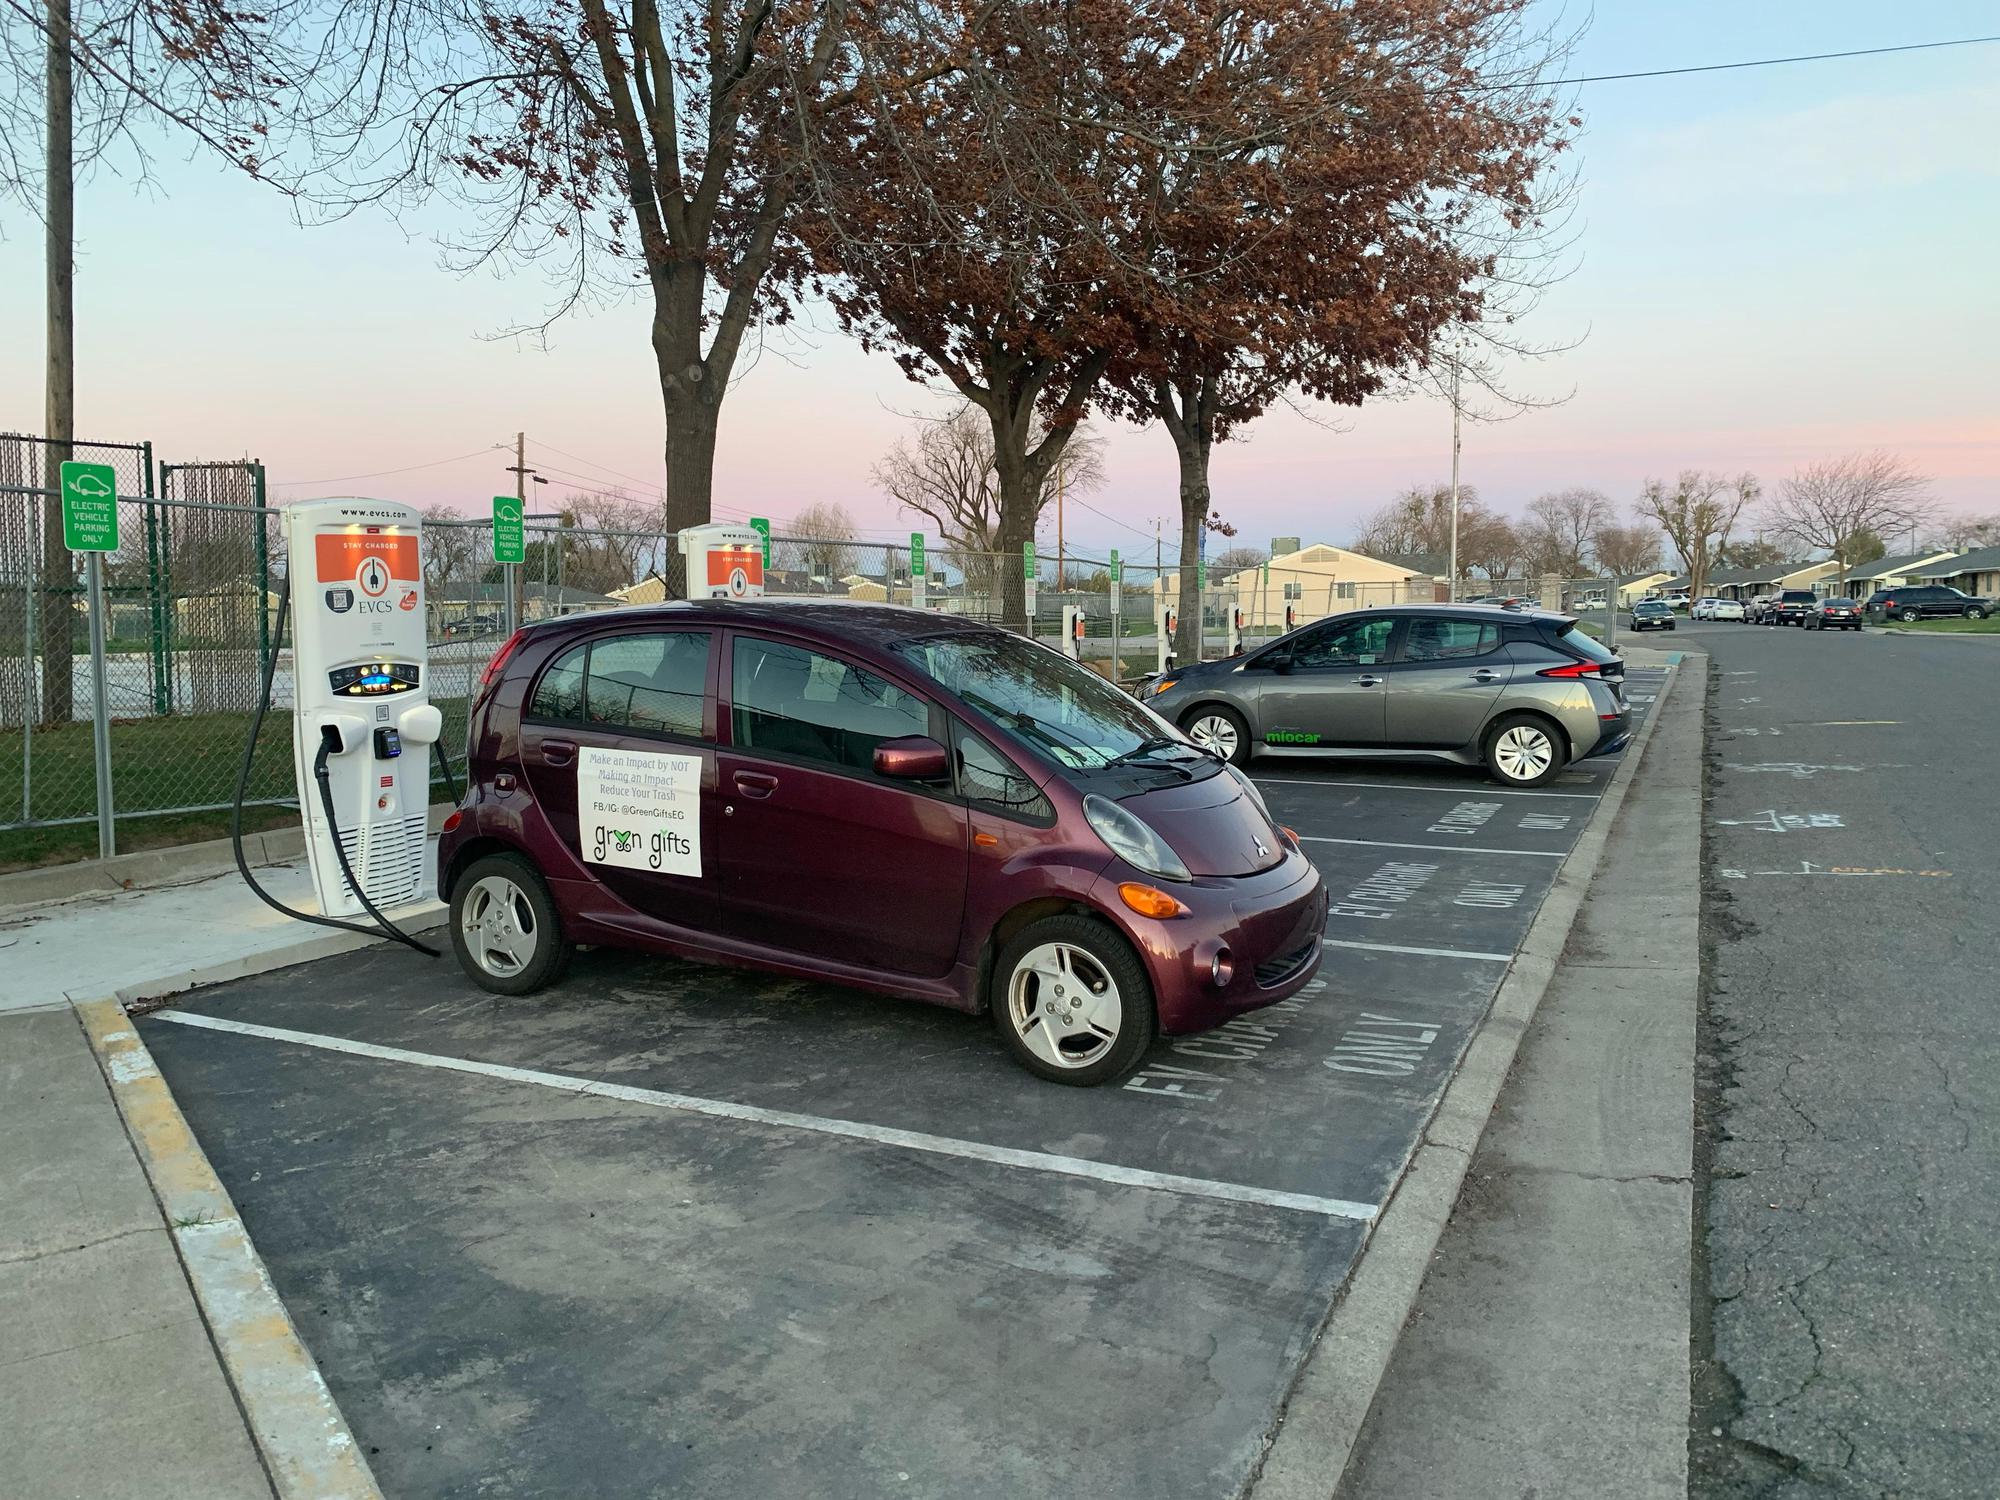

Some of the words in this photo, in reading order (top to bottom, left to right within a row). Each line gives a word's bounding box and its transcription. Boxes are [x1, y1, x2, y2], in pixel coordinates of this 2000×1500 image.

[71, 501, 110, 511] ELECTRIC
[340, 509, 408, 519] www.evcs.com
[74, 512, 109, 522] VEHICLE
[74, 523, 110, 533] PARKING
[81, 534, 103, 543] ONLY
[359, 600, 393, 614] EVCS
[589, 753, 612, 766] Make
[613, 757, 624, 766] an
[626, 757, 656, 771] Impact
[657, 760, 669, 772] by
[671, 761, 690, 772] NOT
[598, 769, 629, 784] Making
[630, 774, 642, 784] an
[600, 784, 630, 797] Reduce
[632, 788, 650, 799] Your
[653, 789, 676, 801] Trash
[593, 802, 620, 813] FB/IG:
[622, 805, 685, 820] @GreenGiftsEG
[1517, 812, 1572, 830] ONLY
[648, 828, 691, 870] gifts
[1347, 862, 1439, 902] CHARGING
[1453, 880, 1527, 908] ONLY
[1327, 902, 1398, 920] EV
[1322, 1012, 1442, 1076] ONLY
[1122, 1062, 1234, 1101] EV
